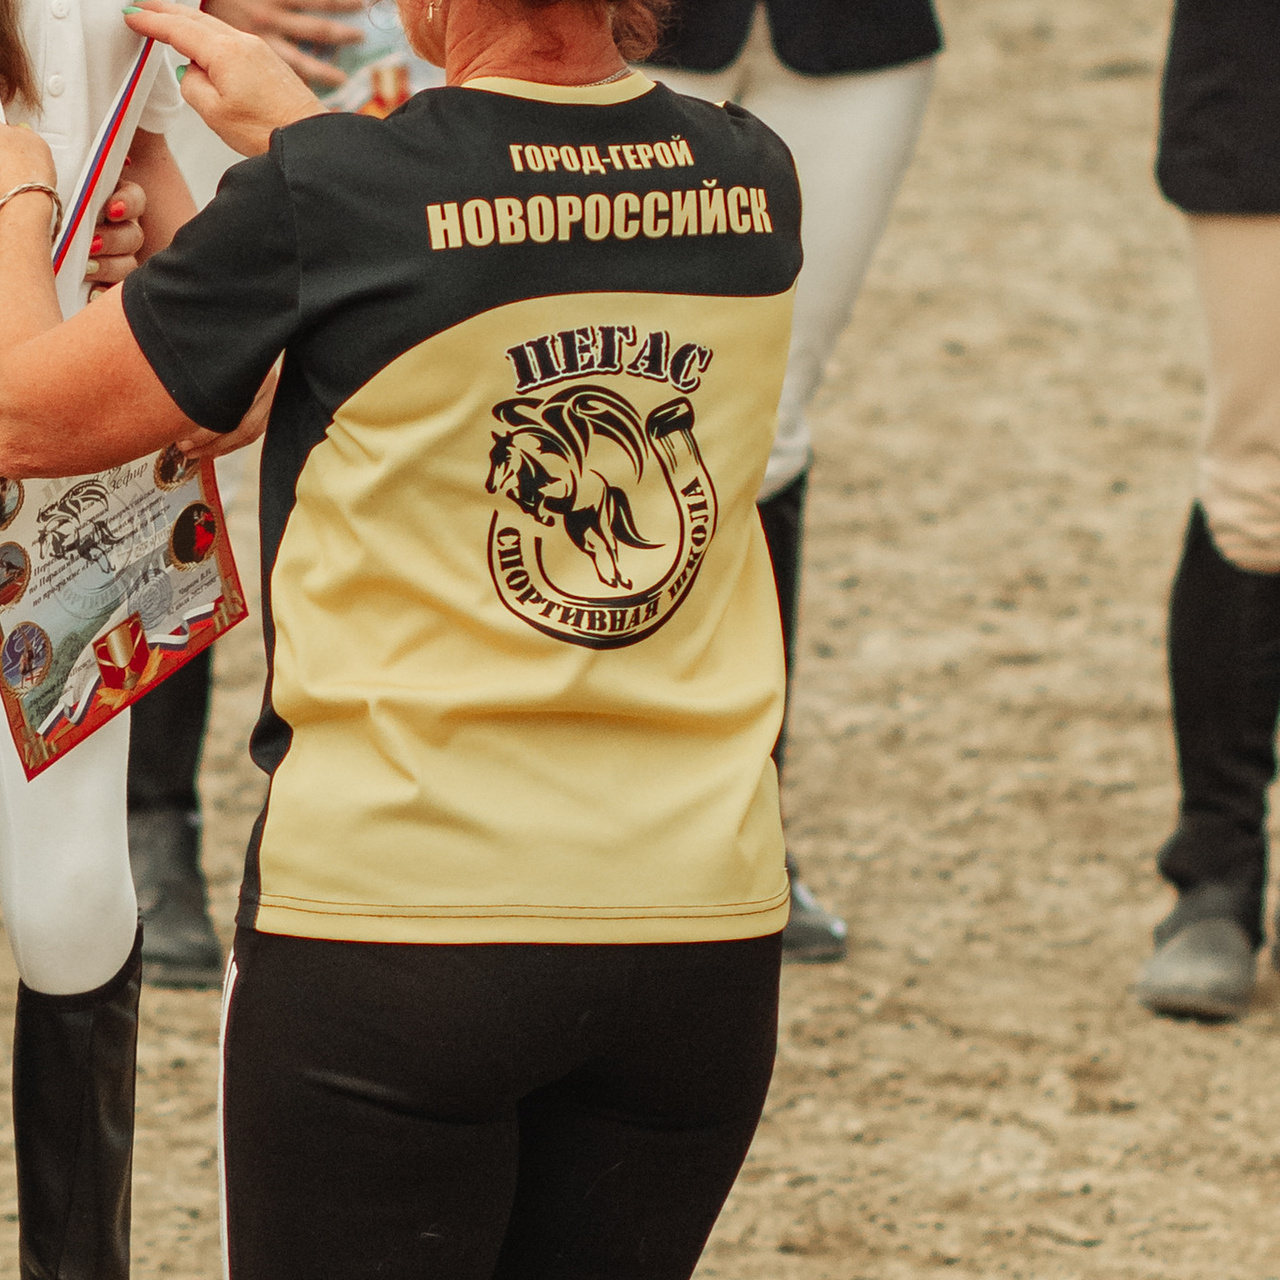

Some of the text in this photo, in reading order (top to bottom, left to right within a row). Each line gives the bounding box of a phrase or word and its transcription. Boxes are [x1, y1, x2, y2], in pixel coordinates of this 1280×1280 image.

[508, 135, 695, 176] ГОРОД-ГЕРОЙ
[425, 179, 773, 250] НОВОРОССИЙСК
[504, 324, 713, 395] ПЕГАС
[495, 475, 712, 633] СПОРТИВНАЯ ШКОЛА
